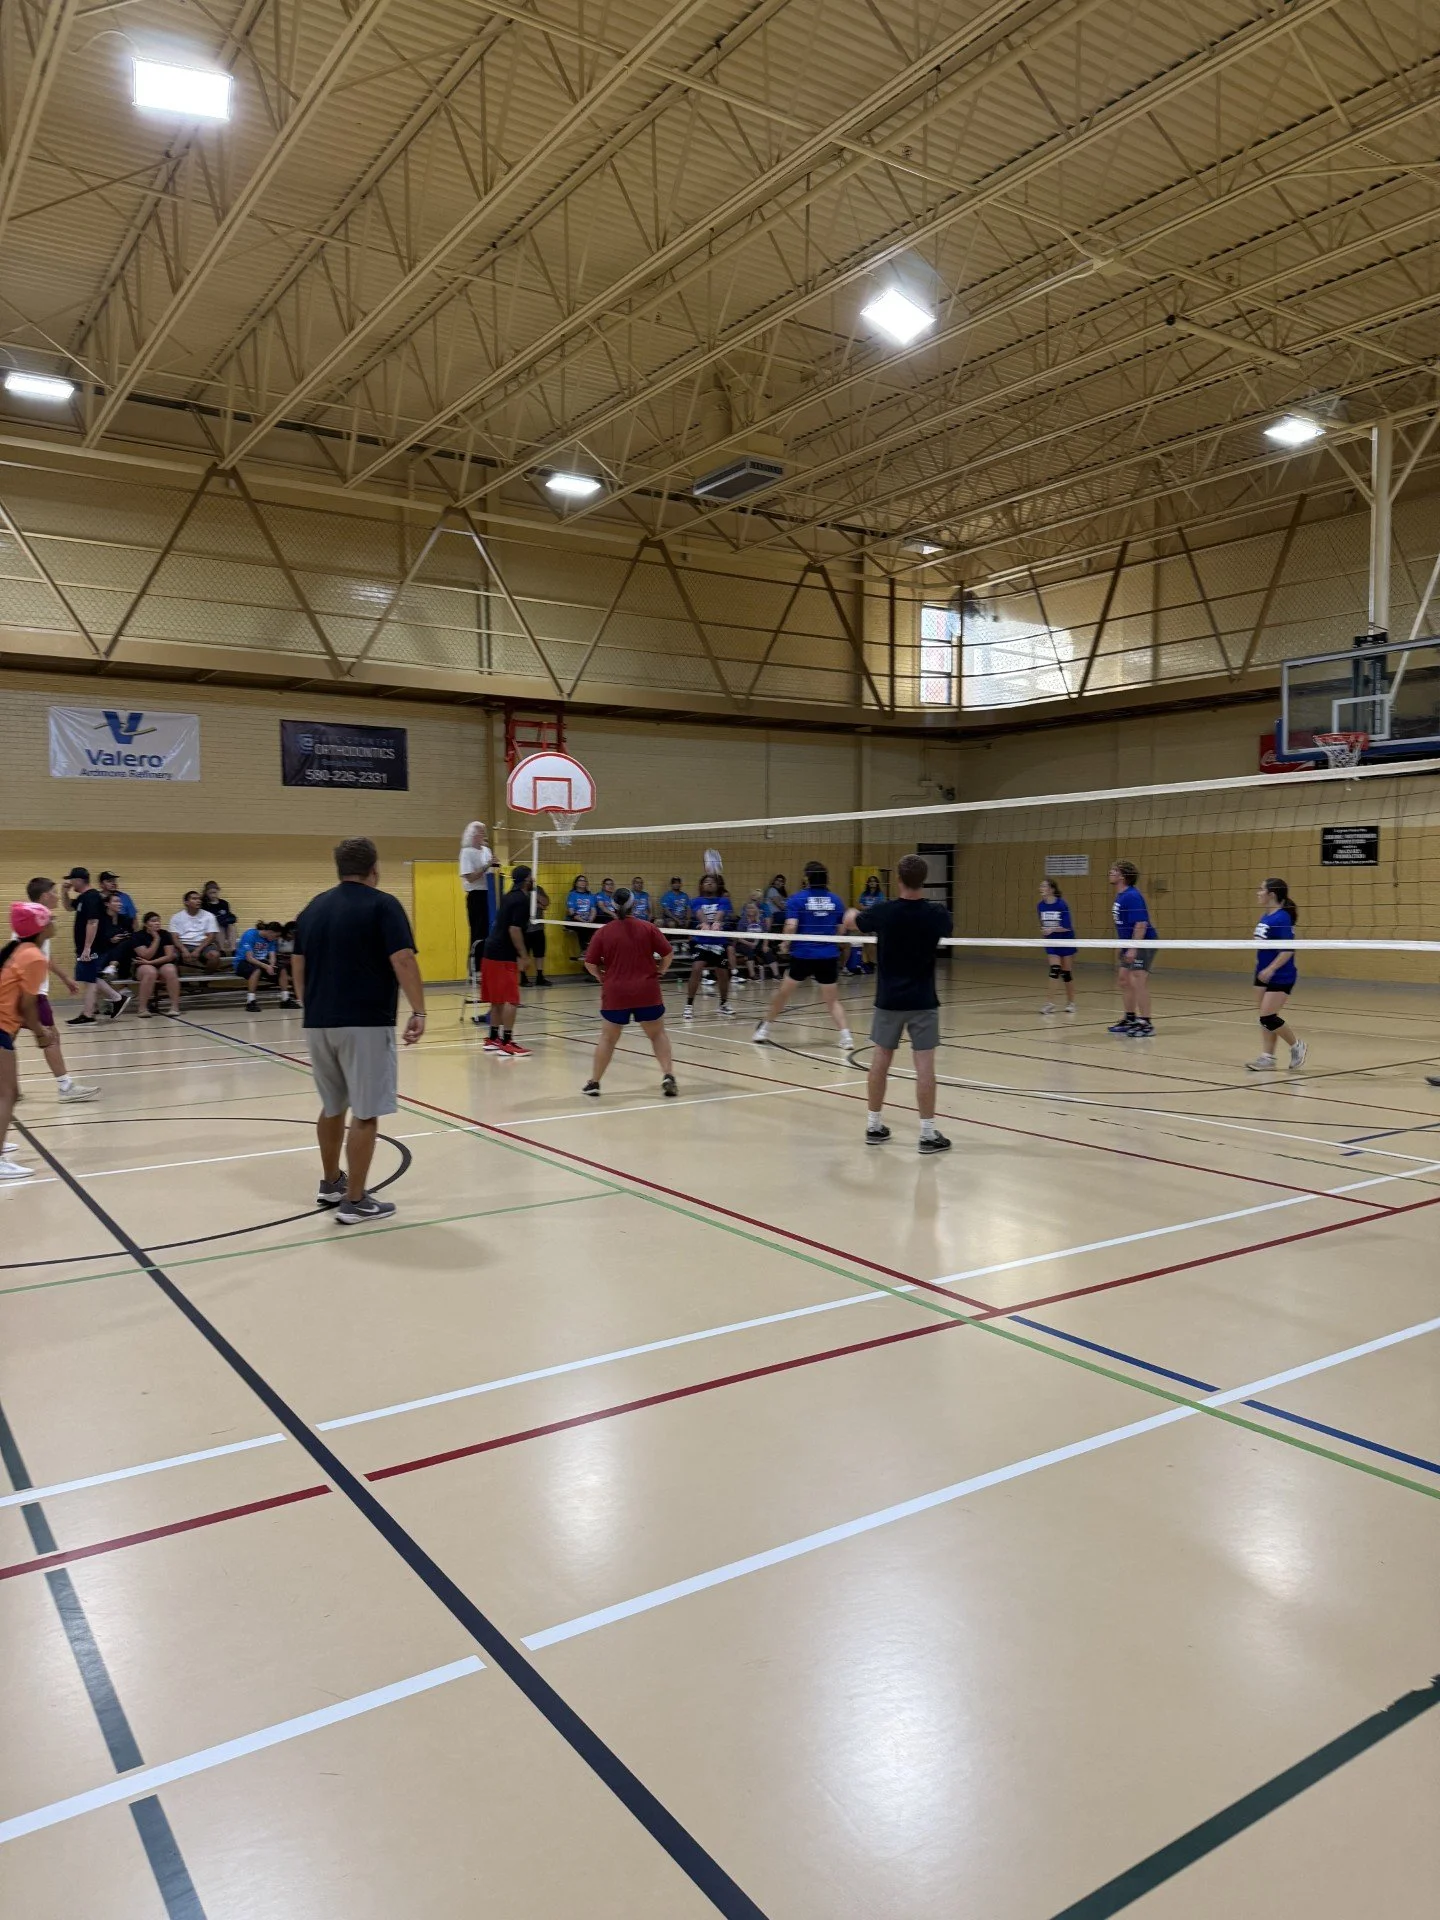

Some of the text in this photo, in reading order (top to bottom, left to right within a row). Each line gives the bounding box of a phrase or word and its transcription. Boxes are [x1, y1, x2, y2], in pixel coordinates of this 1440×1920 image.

[84, 749, 163, 768] Valero
[314, 744, 396, 759] ORTHODONTICS
[128, 769, 172, 780] Refinery
[305, 769, 388, 783] 580-226-2331
